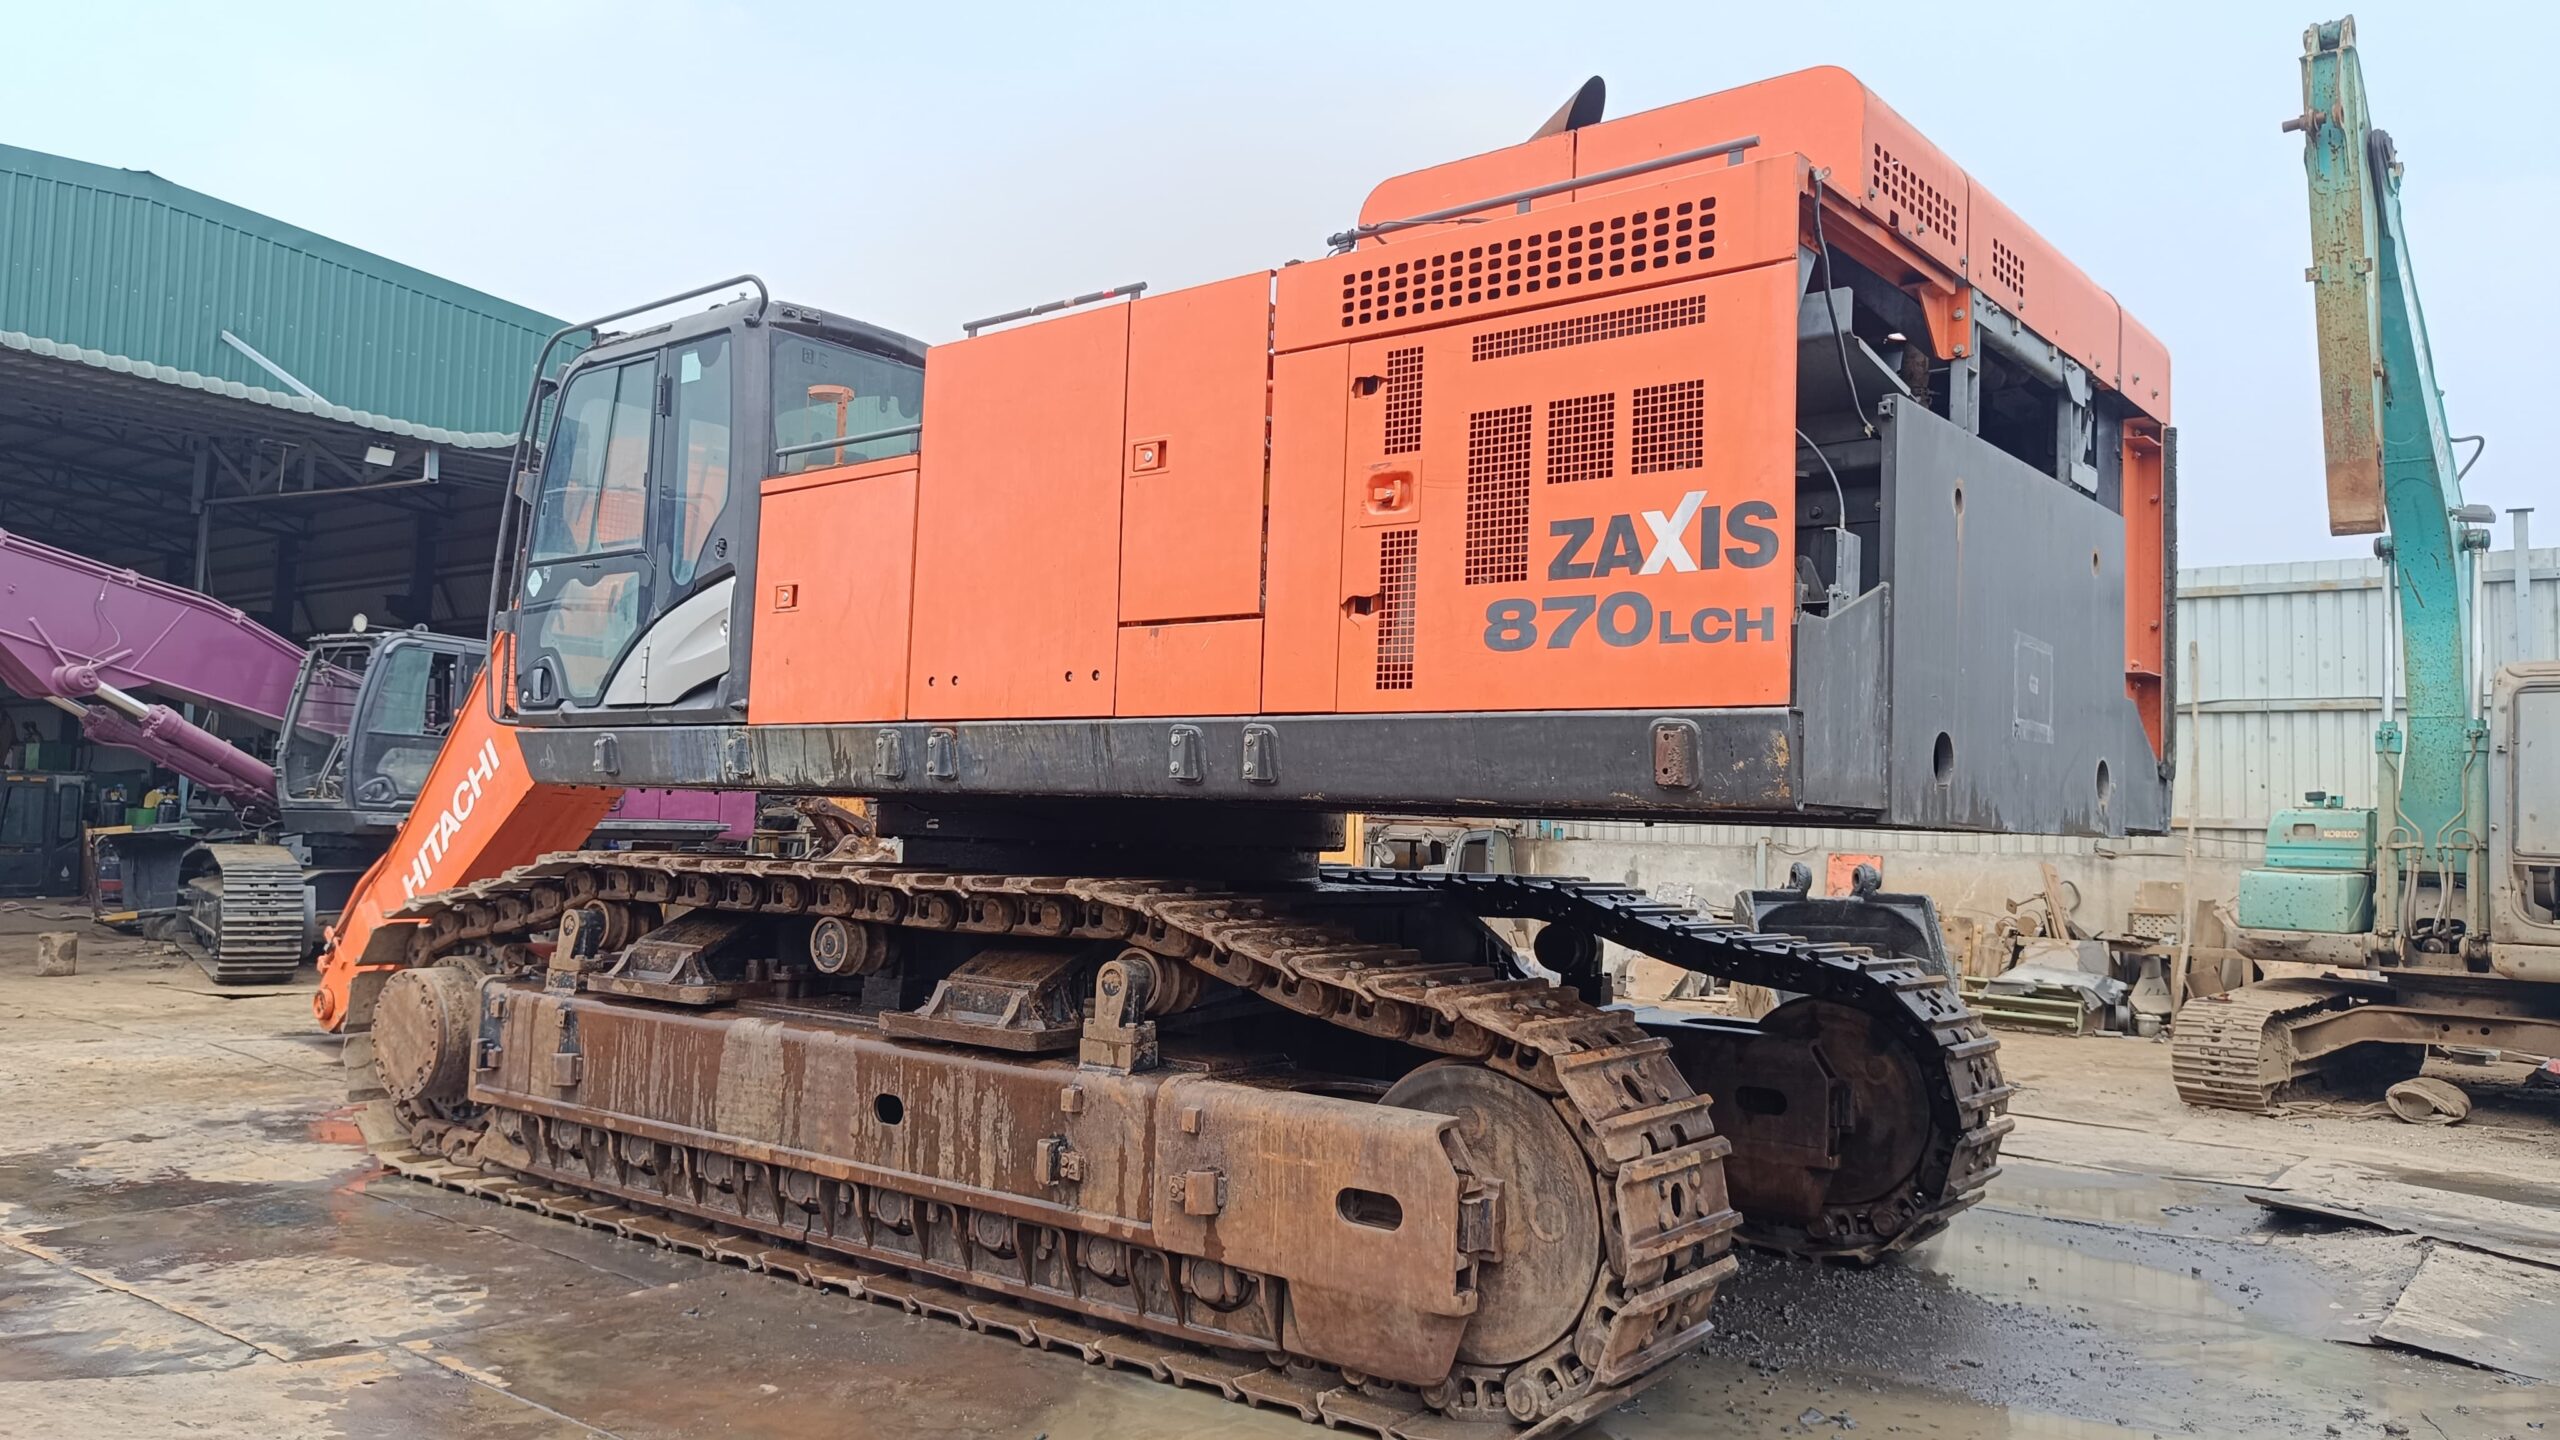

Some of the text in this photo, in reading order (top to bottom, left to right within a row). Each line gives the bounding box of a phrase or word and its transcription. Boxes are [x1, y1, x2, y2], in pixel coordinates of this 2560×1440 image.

[1548, 490, 1779, 581] ZAXIS
[1484, 591, 1774, 652] 870LCH
[402, 738, 500, 899] HITACHI
